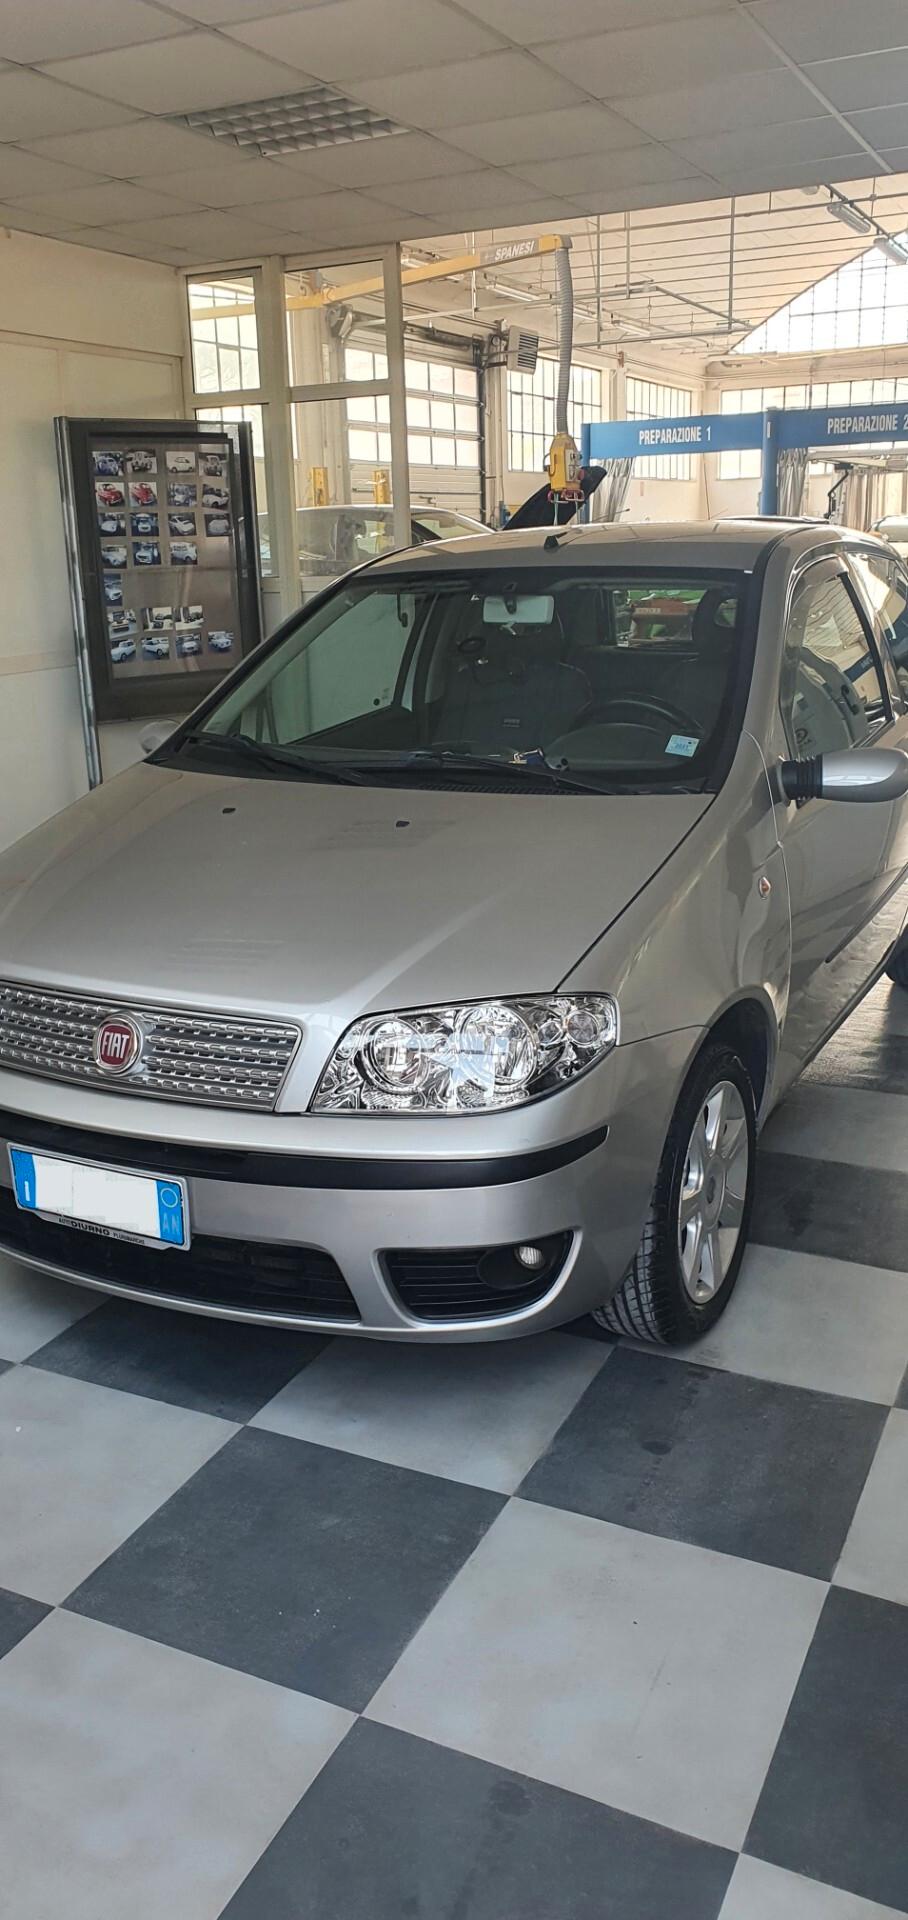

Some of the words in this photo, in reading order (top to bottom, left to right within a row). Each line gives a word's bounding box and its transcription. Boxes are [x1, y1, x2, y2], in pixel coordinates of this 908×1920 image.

[494, 240, 535, 261] SPANESI
[827, 414, 898, 434] PREPARAZIONE
[639, 425, 702, 445] PREPARAZIONE
[706, 426, 711, 441] 1
[102, 1031, 130, 1059] FIAT
[162, 1213, 181, 1235] AN
